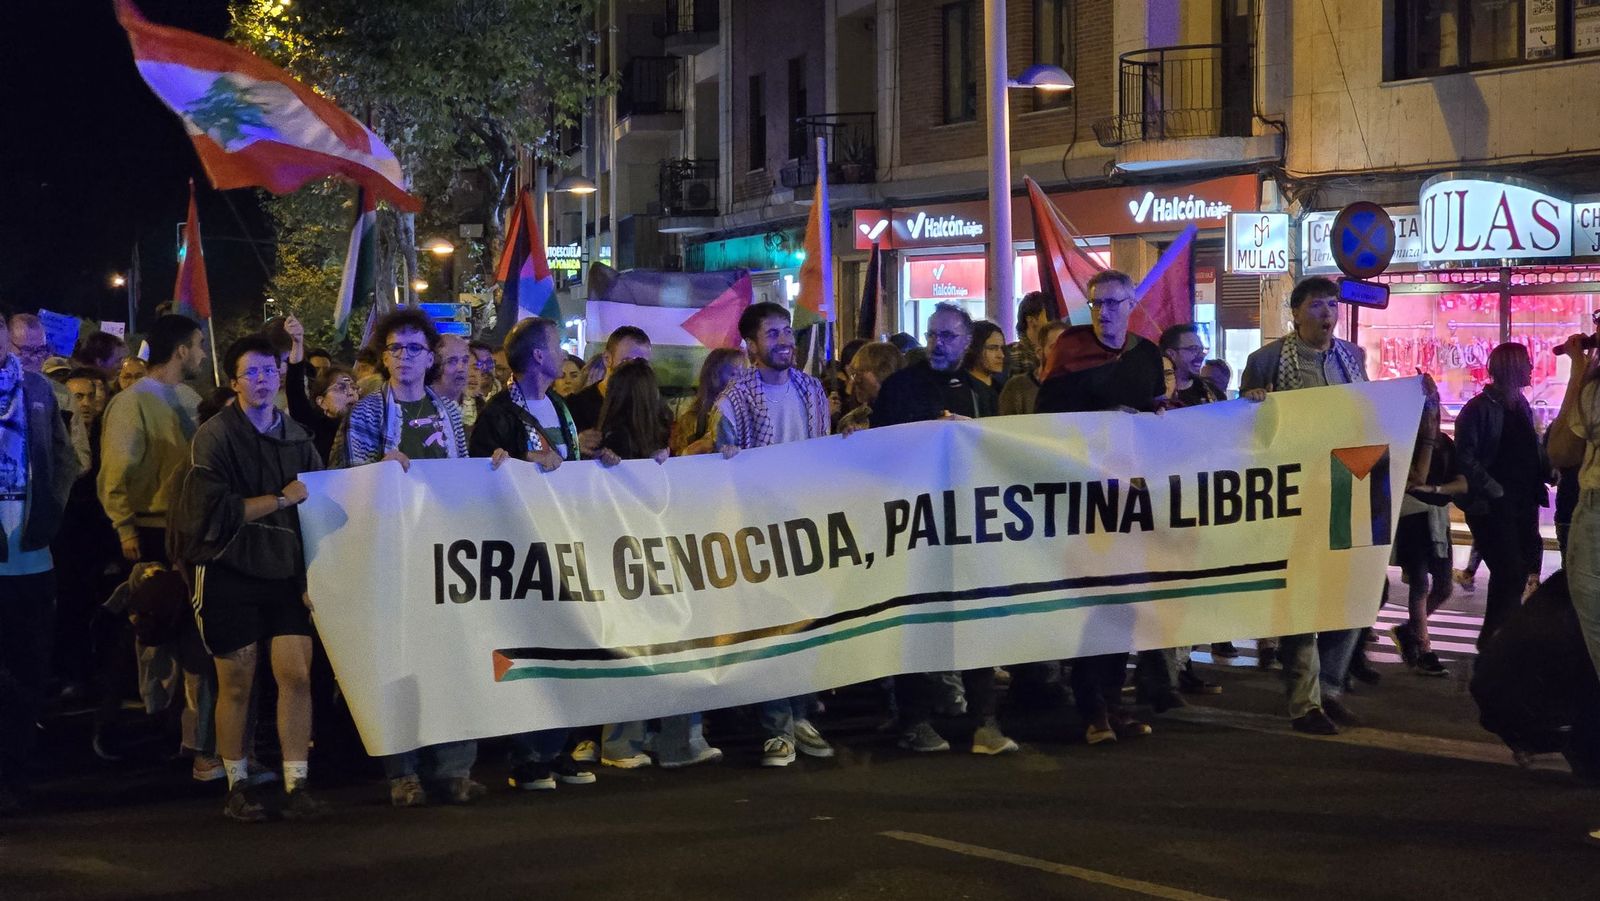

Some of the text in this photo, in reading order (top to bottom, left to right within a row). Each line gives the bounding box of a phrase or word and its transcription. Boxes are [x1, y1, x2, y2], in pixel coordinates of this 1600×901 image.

[1153, 194, 1232, 222] Halcón viajes
[925, 214, 983, 239] Halcón viajes
[1424, 190, 1562, 254] ULAS
[1237, 249, 1286, 269] MULAS
[932, 283, 957, 296] Halcón
[434, 463, 1303, 604] ISRAEL GENOCIDA, PALESTINA LIBRE
